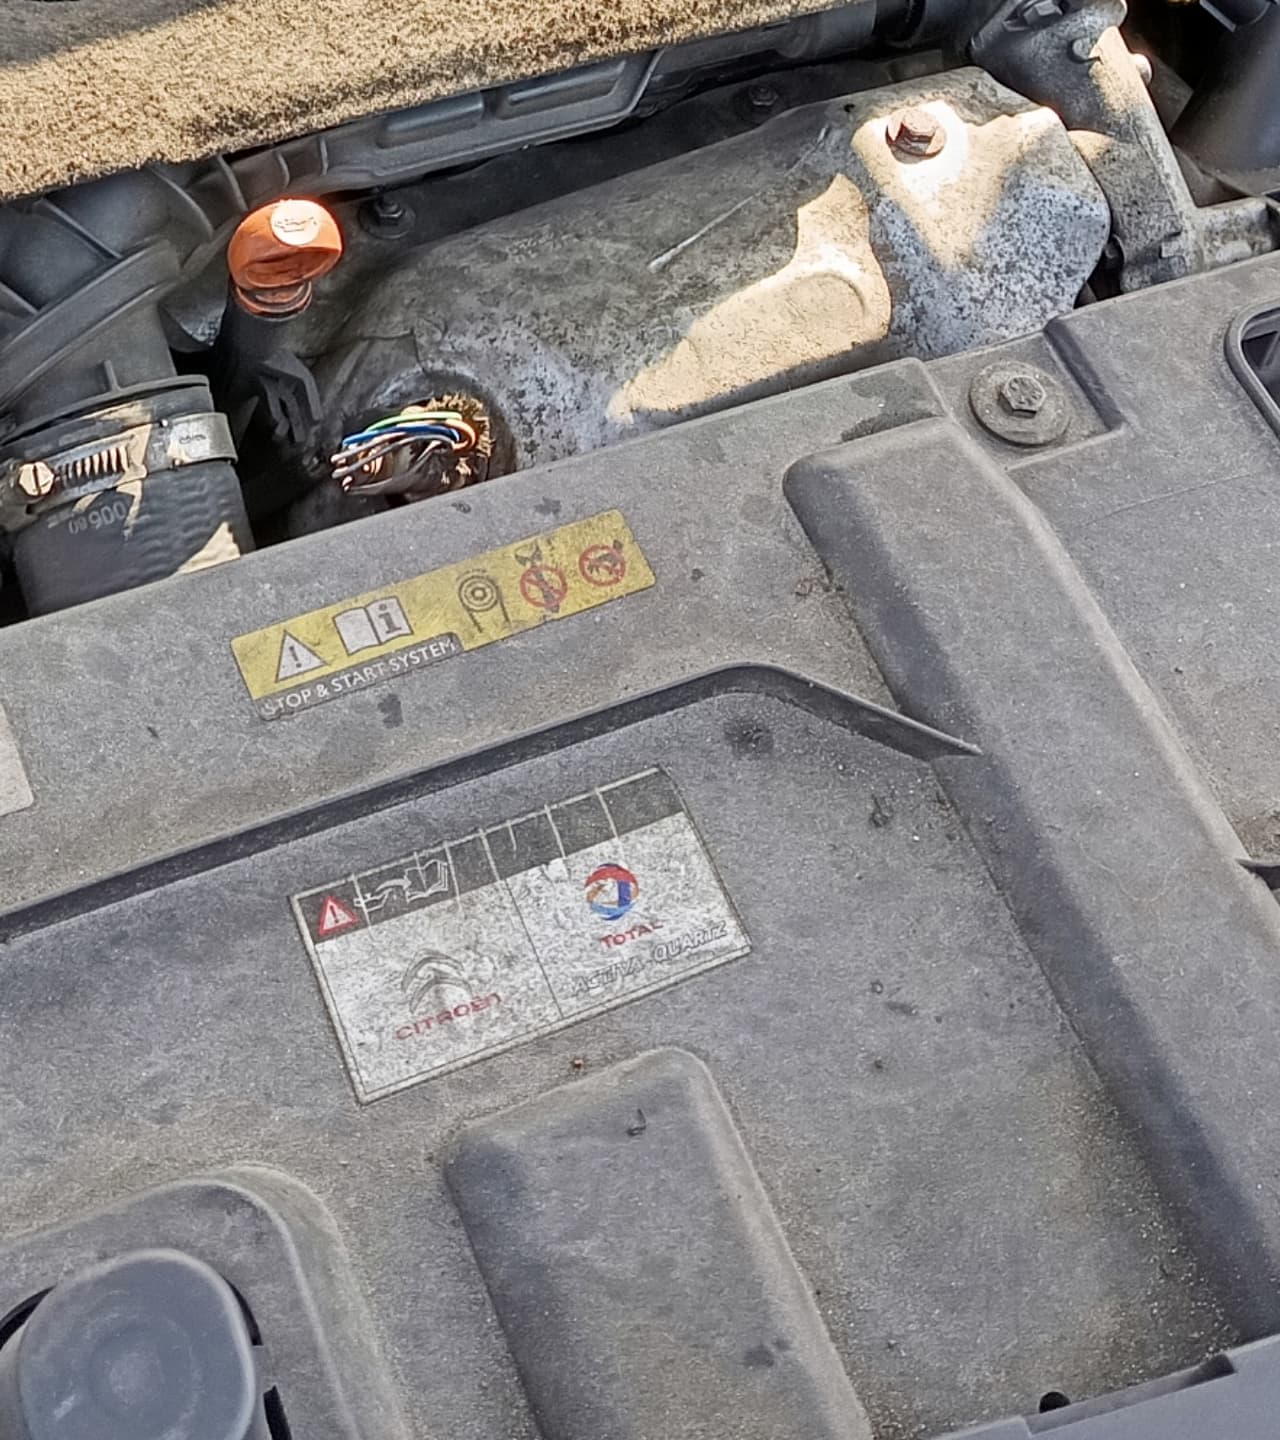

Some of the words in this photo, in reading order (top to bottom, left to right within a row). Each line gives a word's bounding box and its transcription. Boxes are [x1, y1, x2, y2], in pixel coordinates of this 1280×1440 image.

[264, 688, 312, 716] STOP
[315, 684, 330, 698] &
[331, 662, 386, 693] START
[388, 638, 456, 672] SYSTEM
[600, 921, 665, 949] TOTAL
